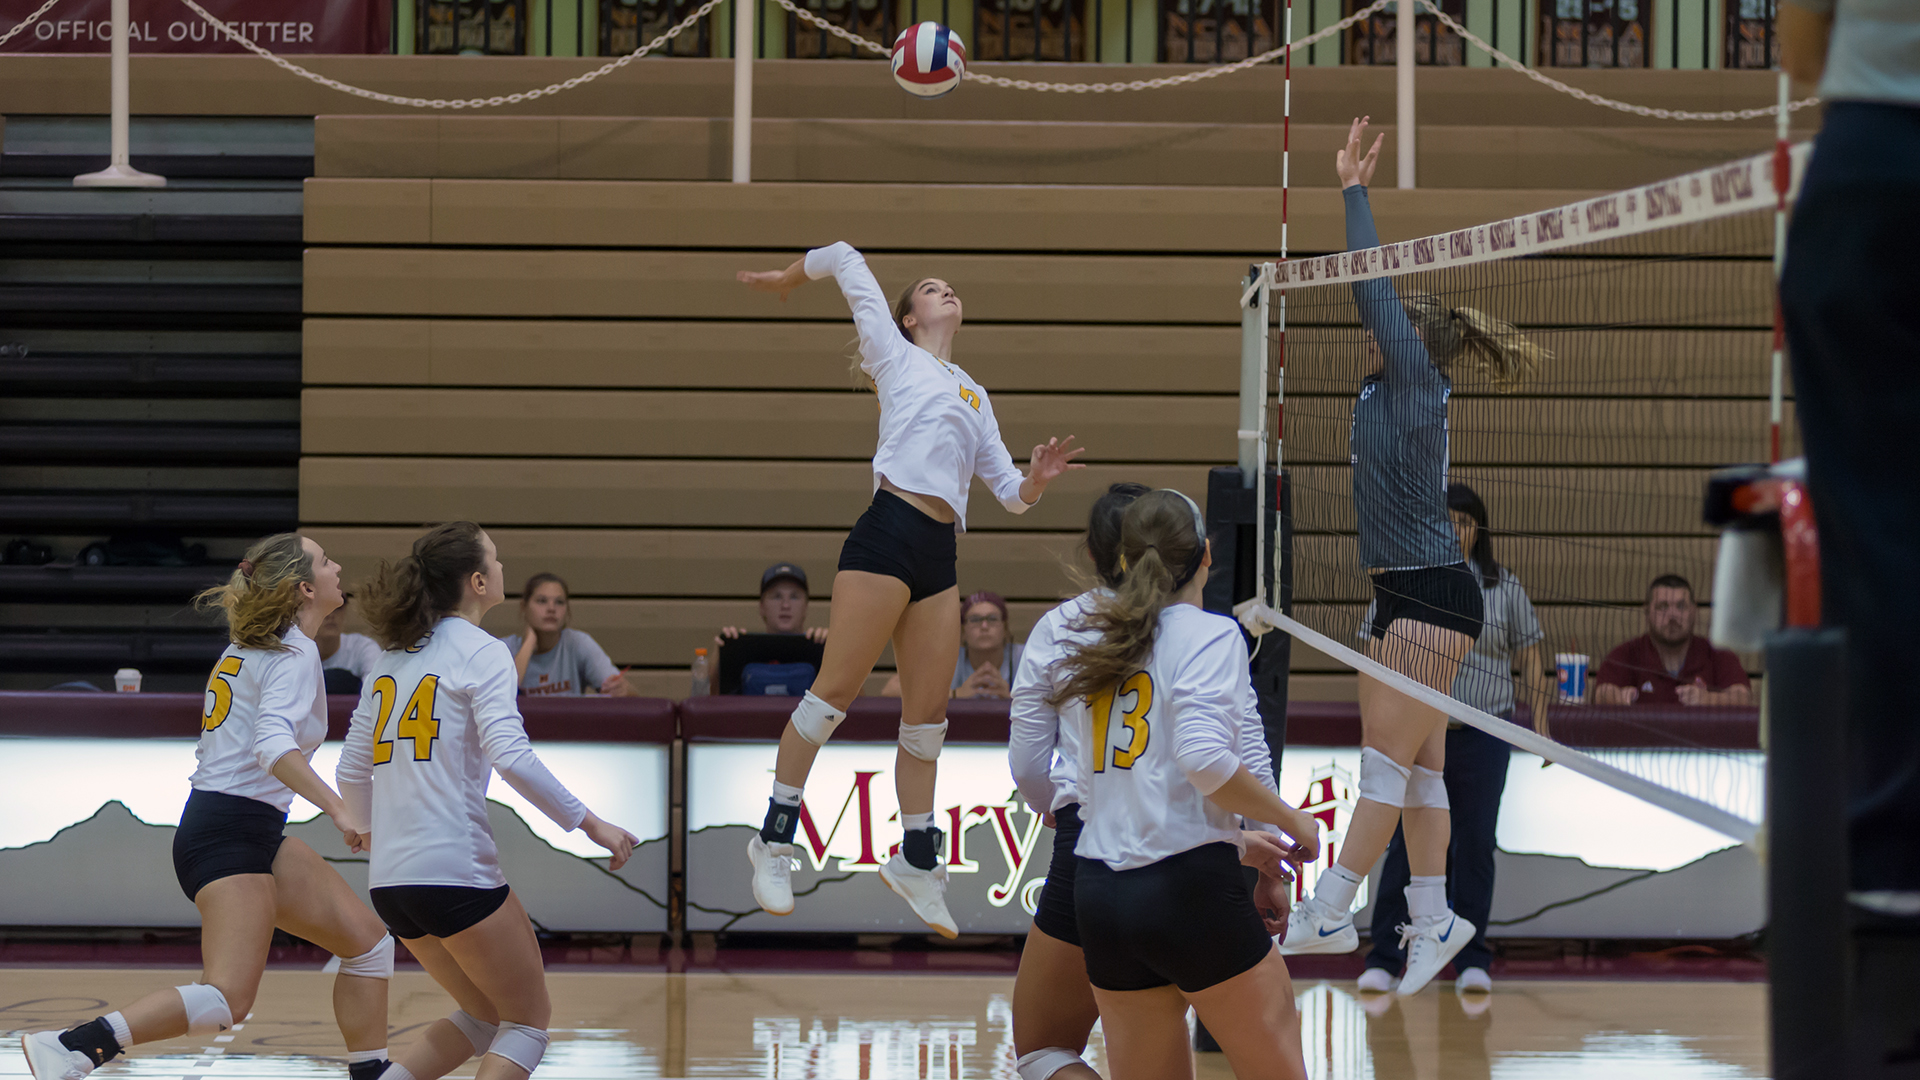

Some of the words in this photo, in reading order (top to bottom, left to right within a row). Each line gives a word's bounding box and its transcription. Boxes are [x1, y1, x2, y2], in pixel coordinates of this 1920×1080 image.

[35, 20, 158, 42] OFFICAL
[167, 21, 314, 43] OUTFITTER
[372, 673, 441, 766] 24
[1085, 669, 1155, 774] 13
